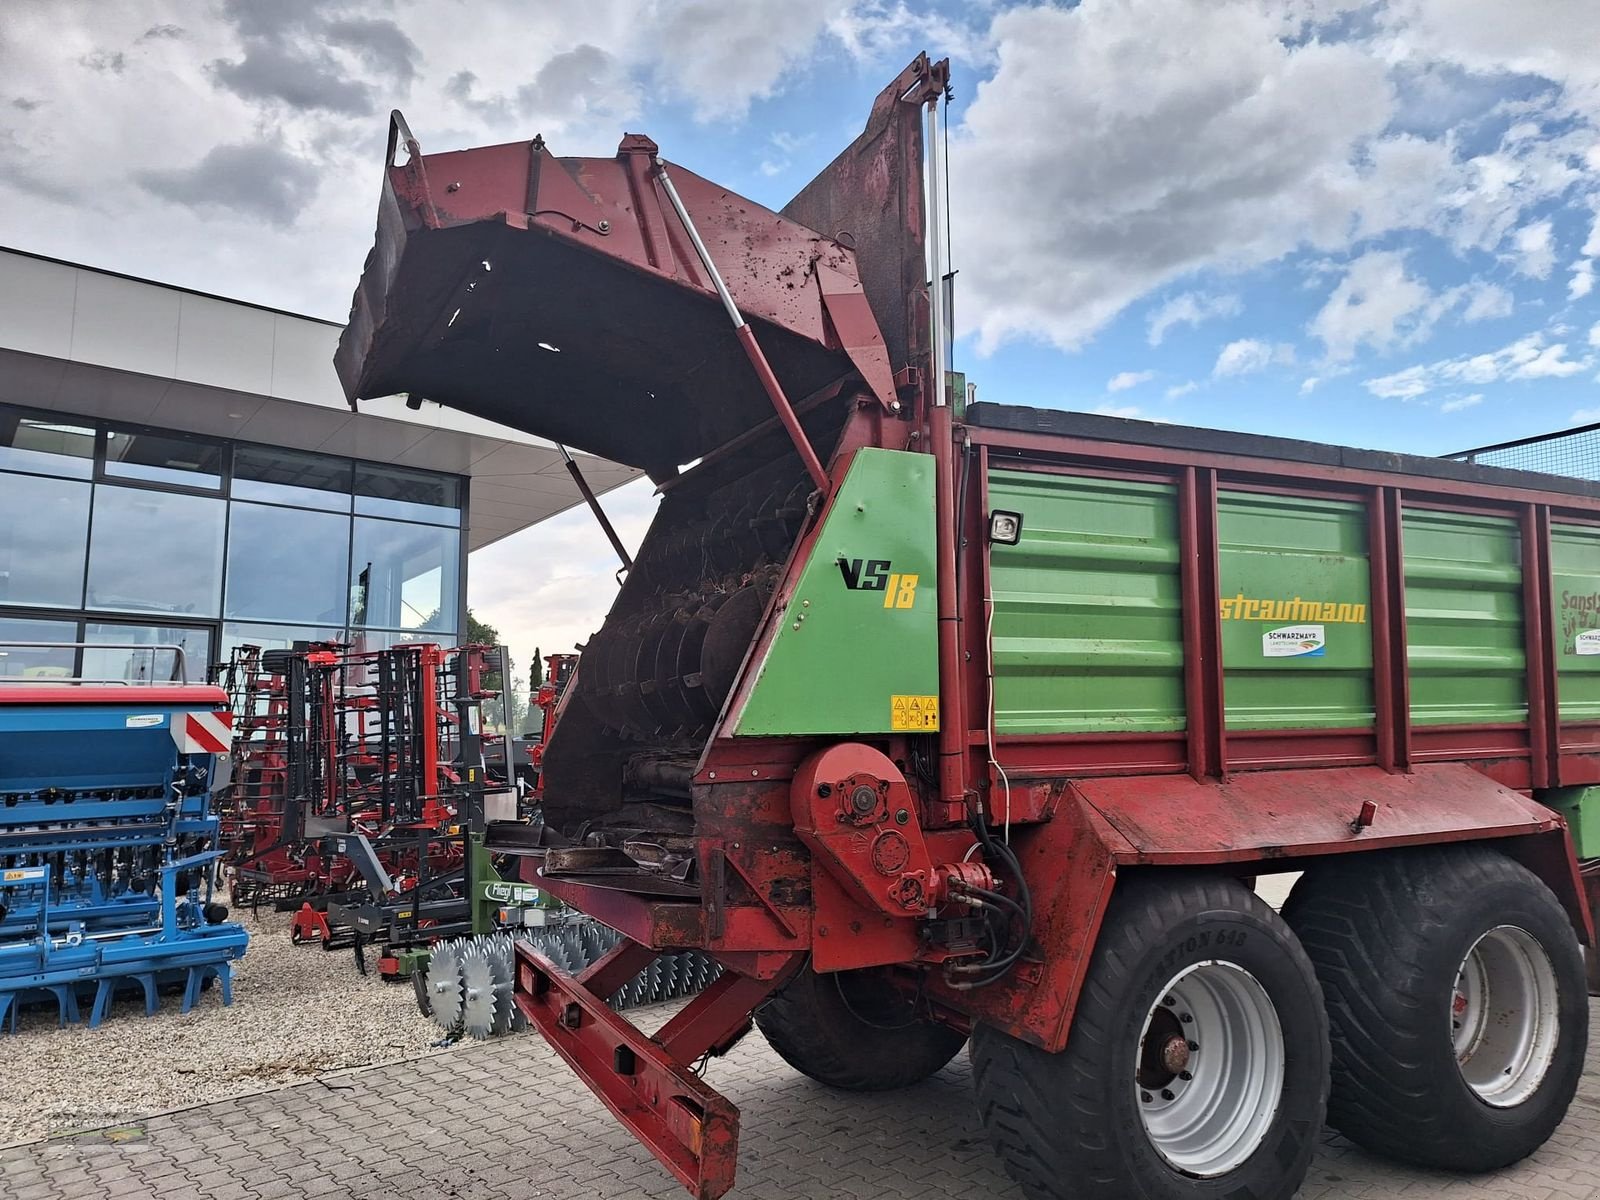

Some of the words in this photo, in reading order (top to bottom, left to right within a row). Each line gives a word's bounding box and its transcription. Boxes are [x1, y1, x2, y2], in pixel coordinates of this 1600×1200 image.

[837, 558, 891, 591] VS
[884, 574, 919, 609] 18
[1220, 593, 1366, 624] strautmann
[1268, 632, 1317, 640] SCHWARZMAYR
[492, 883, 512, 899] Fliegl
